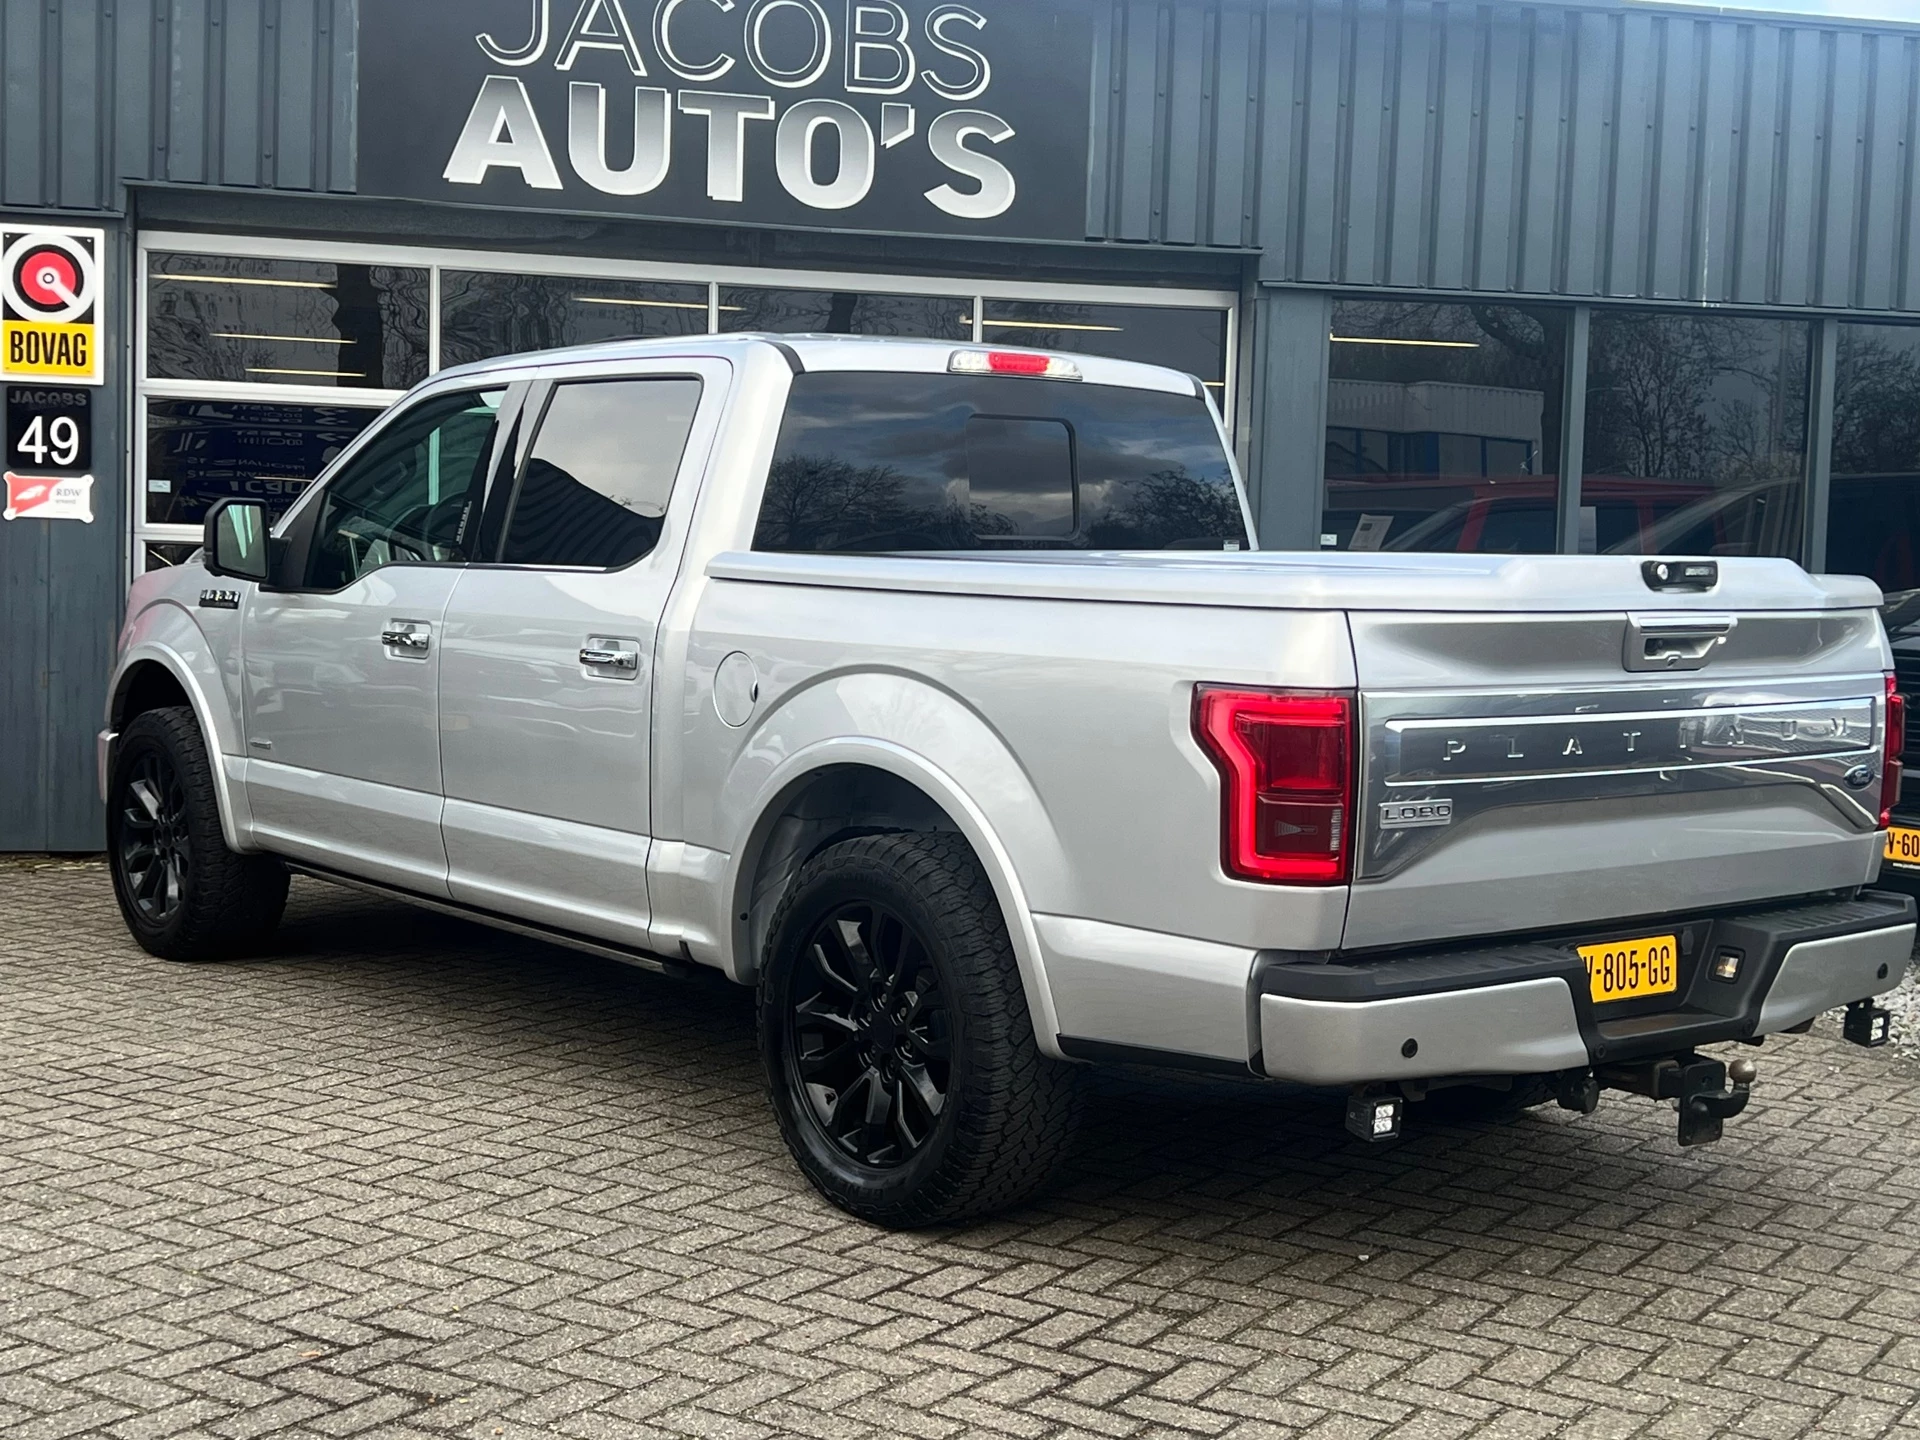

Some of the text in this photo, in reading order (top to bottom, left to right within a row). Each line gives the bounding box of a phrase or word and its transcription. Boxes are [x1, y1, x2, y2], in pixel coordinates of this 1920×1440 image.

[475, 0, 991, 101] JACOBS
[442, 74, 1016, 219] AUTO'S
[10, 330, 87, 367] BOVAG
[9, 390, 87, 406] JACOBS
[17, 416, 79, 465] 49
[56, 488, 82, 497] RDW
[1384, 804, 1451, 821] LOBO
